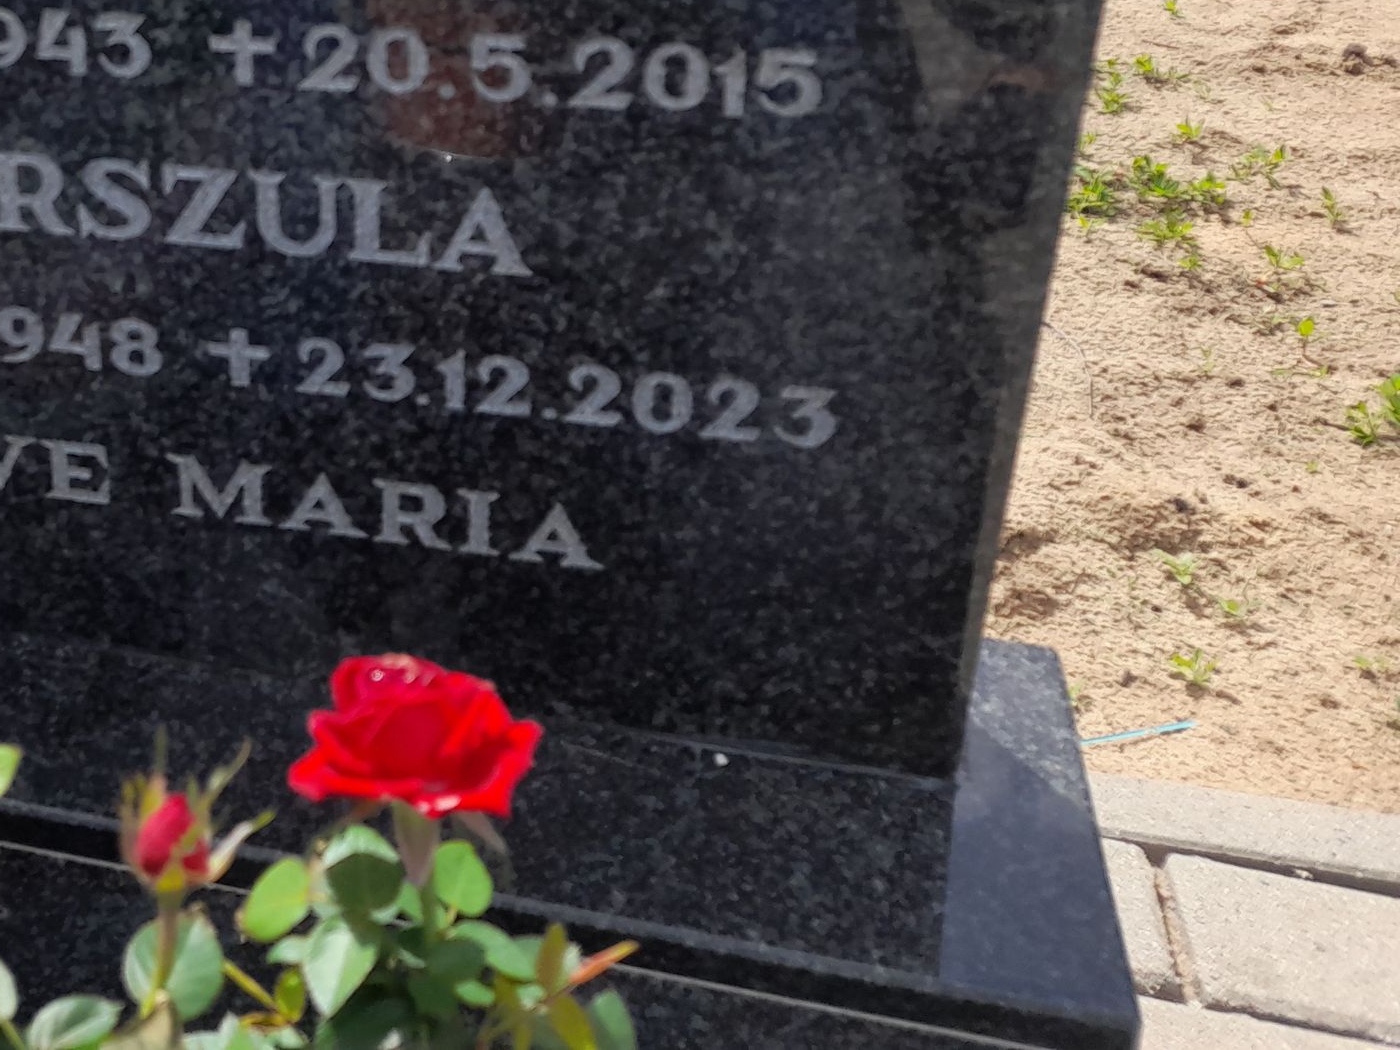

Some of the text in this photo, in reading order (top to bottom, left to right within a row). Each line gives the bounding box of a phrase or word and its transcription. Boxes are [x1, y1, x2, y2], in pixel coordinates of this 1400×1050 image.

[300, 22, 823, 118] 20.5.2015
[295, 336, 837, 448] 23.12.2023
[165, 452, 605, 571] MARIA
